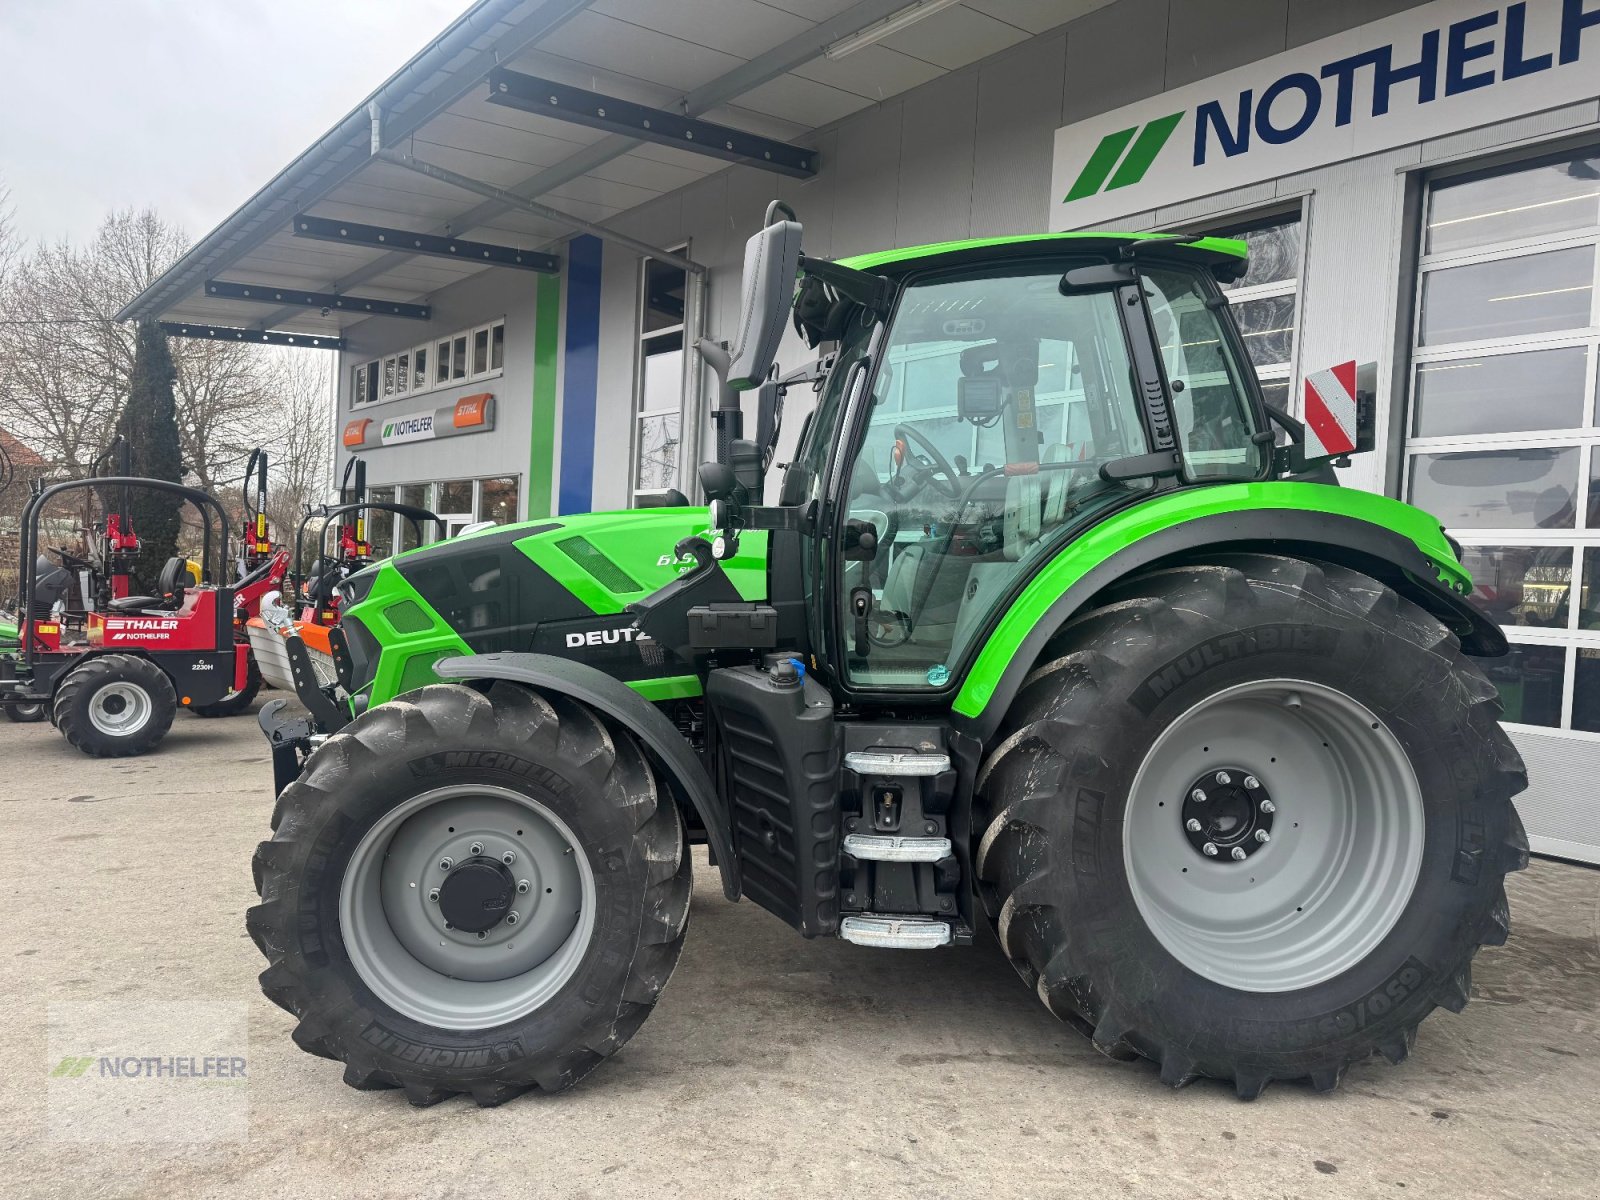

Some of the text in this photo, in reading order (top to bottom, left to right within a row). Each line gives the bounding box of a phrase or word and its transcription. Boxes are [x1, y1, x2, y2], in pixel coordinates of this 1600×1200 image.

[458, 403, 478, 416] STIHL
[345, 428, 360, 437] STIHL
[394, 416, 433, 436] NOTHELFER
[125, 620, 179, 630] THALER
[441, 748, 570, 795] MICHELIN
[362, 1019, 494, 1071] MICHELIN
